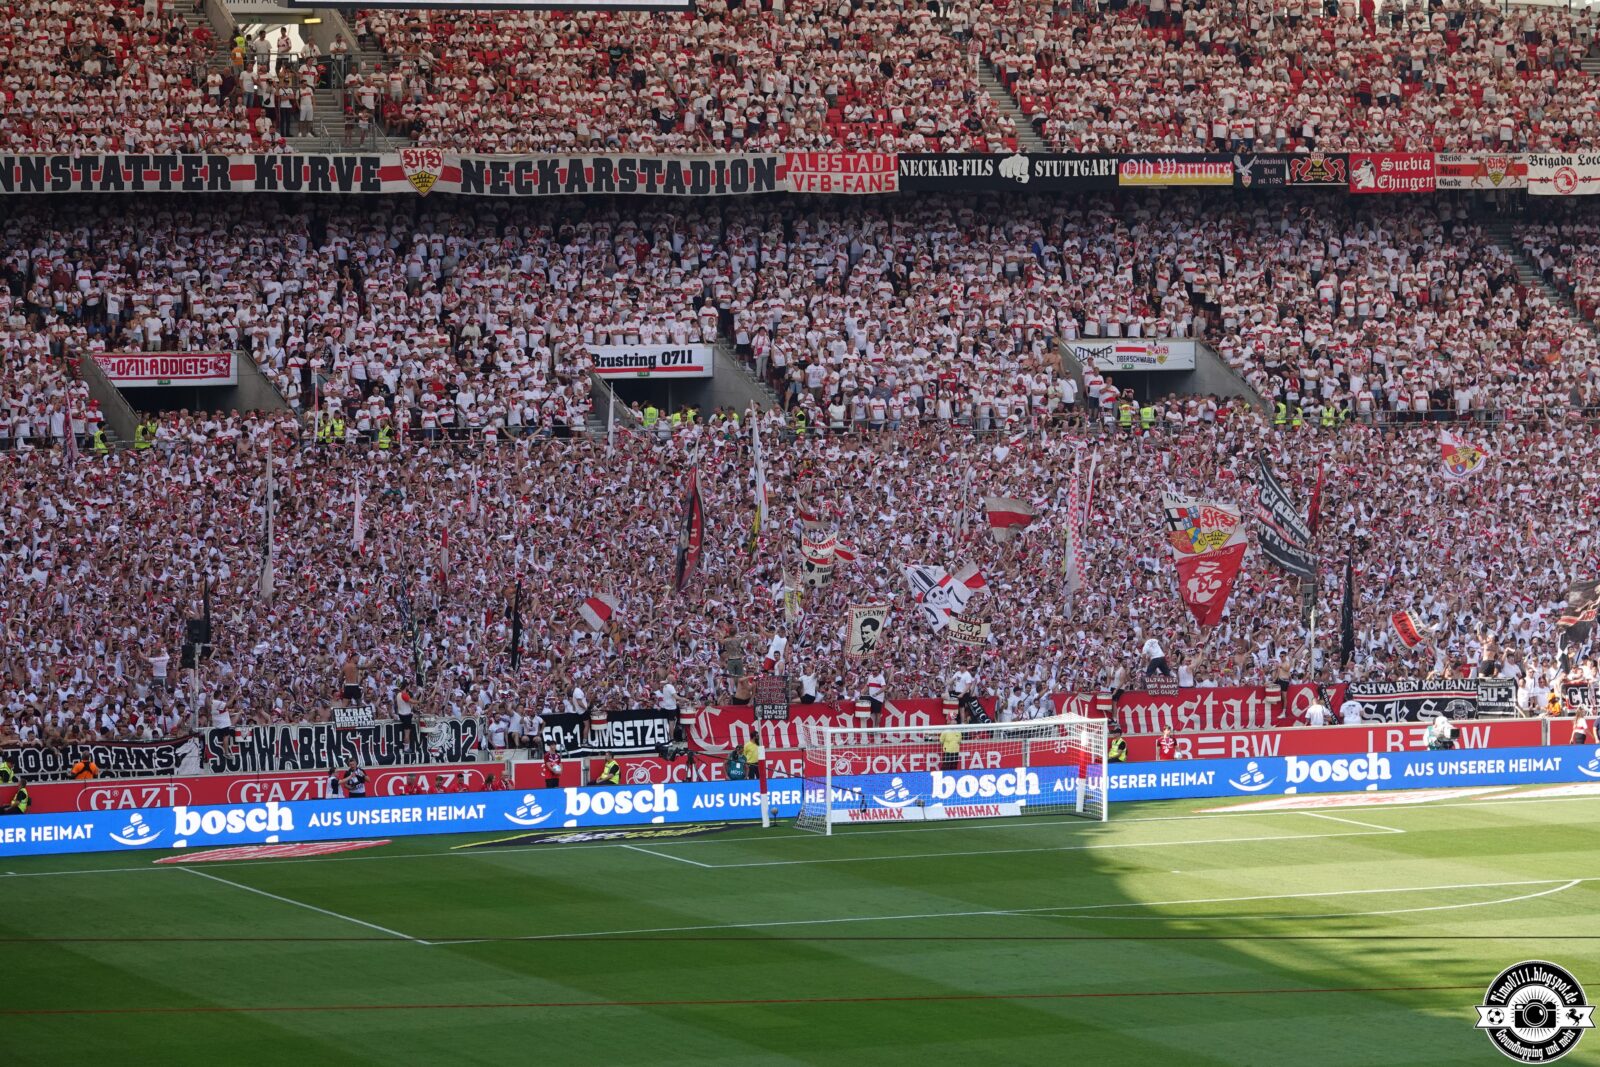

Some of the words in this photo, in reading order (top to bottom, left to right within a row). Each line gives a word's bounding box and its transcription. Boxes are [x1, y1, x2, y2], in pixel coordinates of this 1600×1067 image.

[790, 153, 896, 172] ALBSTADT
[900, 159, 993, 177] NECKAR-FILS
[1035, 158, 1118, 177] STUTTGART
[1122, 158, 1153, 180] Old
[1157, 157, 1233, 180] Warriors
[1381, 157, 1431, 173] Suebia
[1529, 154, 1573, 169] Brigada
[255, 155, 381, 192] KURVE
[460, 157, 777, 195] NECKARSTADION
[1377, 174, 1434, 191] Ehingen
[792, 174, 896, 193] VFB-FANS
[117, 359, 145, 376] 0711
[150, 358, 208, 375] ADDICTS
[592, 353, 656, 369] Brustring
[661, 350, 693, 365] 0711
[1350, 680, 1419, 695] SCHWABEN
[1422, 678, 1478, 692] KOMPANIE
[334, 707, 372, 717] ULTRAS
[1284, 752, 1392, 784] bosch
[1404, 762, 1434, 777] AUS
[1438, 759, 1505, 775] UNSERER
[1509, 757, 1562, 772] HEIMAT
[930, 768, 1040, 800] bosch
[1160, 770, 1216, 788] HEIMAT
[563, 783, 679, 816] bosch
[692, 793, 725, 809] AUS
[729, 789, 801, 807] UNSERER
[806, 785, 862, 804] HEMAT
[173, 801, 294, 837] bosch
[308, 811, 342, 828] AUS
[347, 808, 423, 826] UNSERER
[426, 804, 487, 822] HEIMAT
[848, 807, 904, 821] WINAMAX
[945, 803, 1001, 818] WINAMAX
[31, 824, 94, 842] HEIMAT
